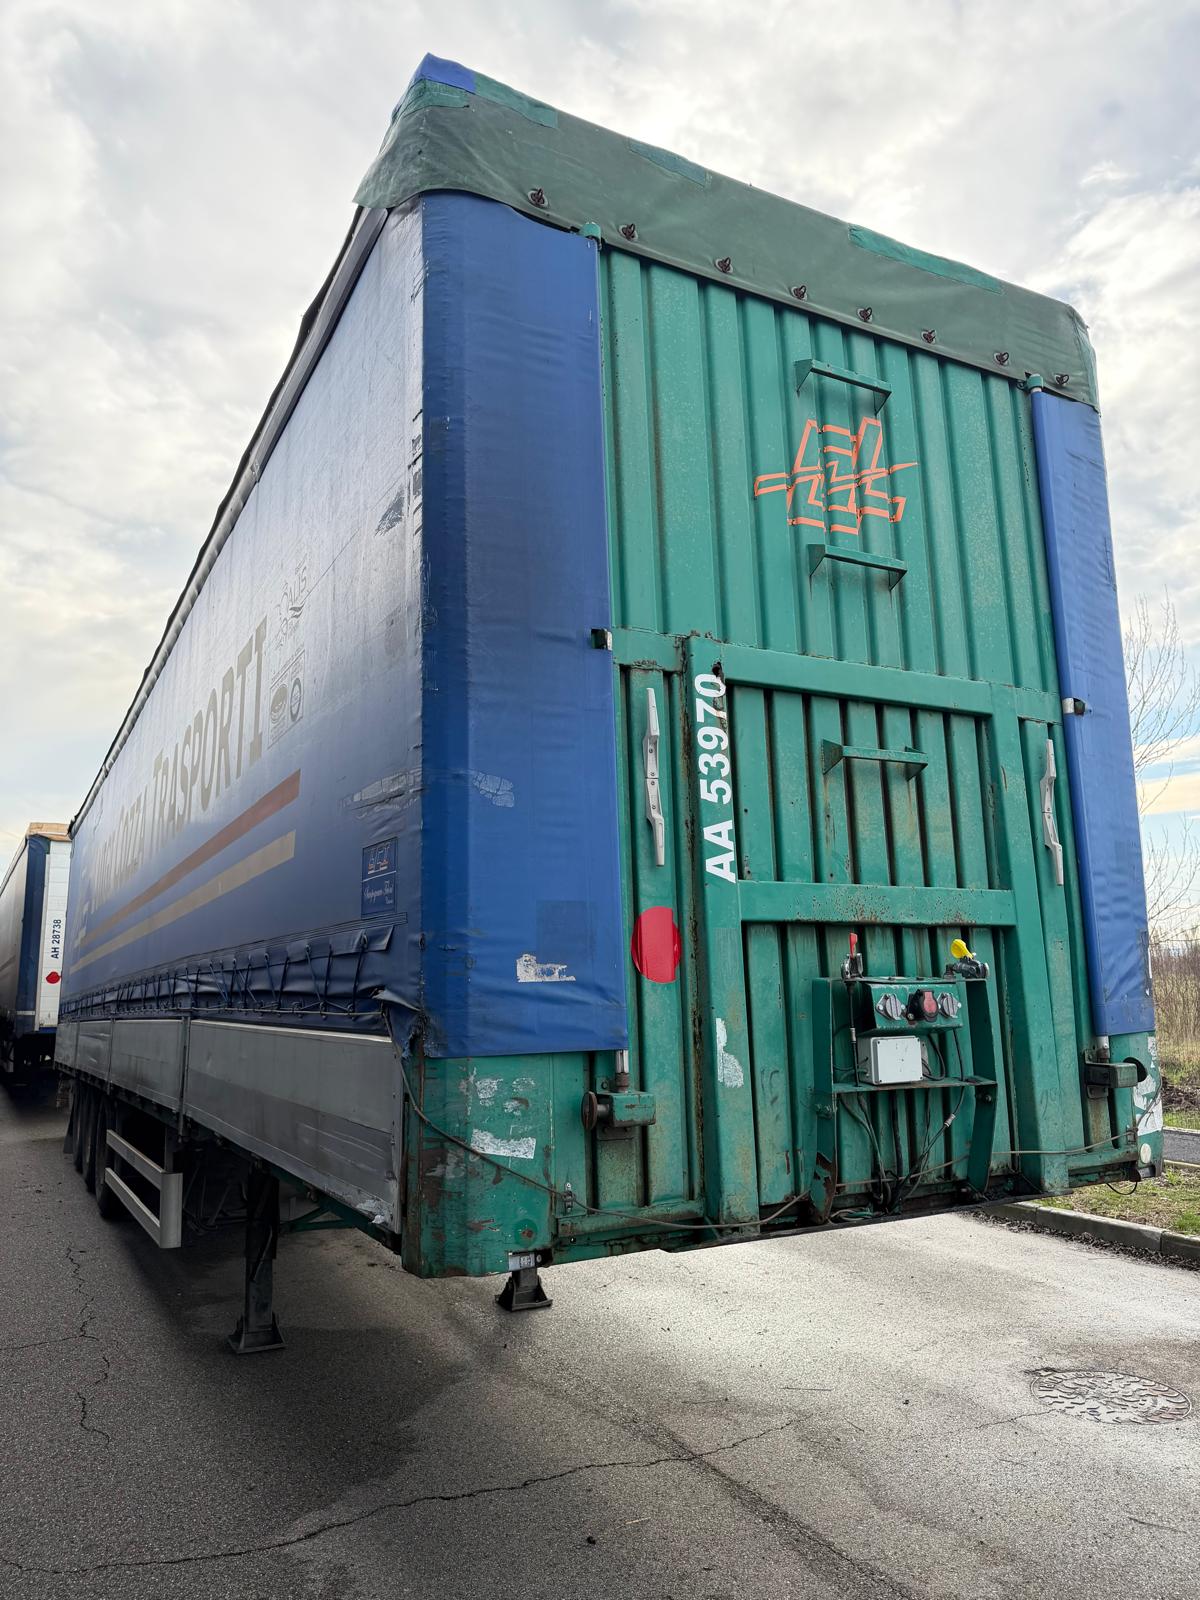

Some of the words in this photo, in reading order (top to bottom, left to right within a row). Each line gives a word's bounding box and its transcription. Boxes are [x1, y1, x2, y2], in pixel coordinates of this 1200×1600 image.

[150, 614, 267, 854] TRASPORTI
[694, 673, 732, 804] 53970
[703, 819, 737, 884] AA
[51, 947, 60, 959] AH
[52, 919, 61, 944] 28738
